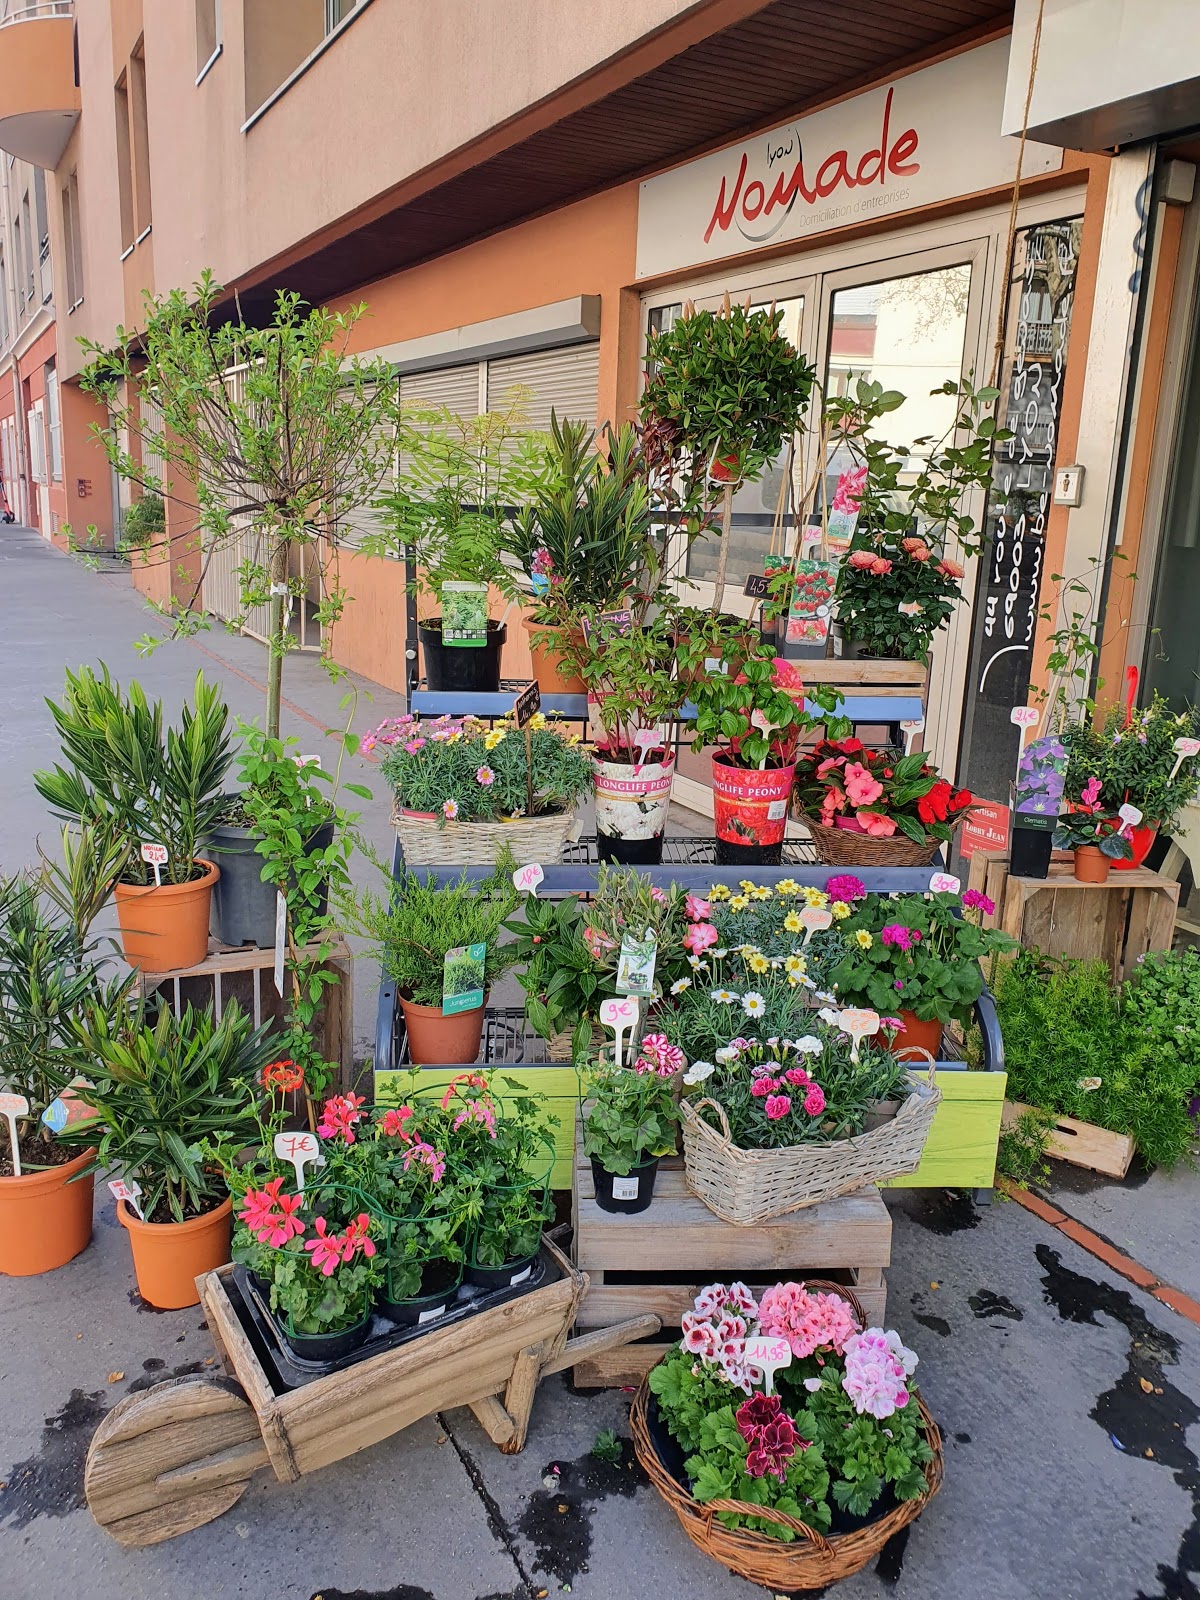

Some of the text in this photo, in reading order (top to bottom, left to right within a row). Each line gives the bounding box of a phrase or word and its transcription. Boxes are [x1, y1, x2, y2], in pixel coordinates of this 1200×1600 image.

[703, 87, 920, 244] Nomade
[799, 188, 910, 227] Domiciliation d'entreprises
[1004, 363, 1042, 639] 69003 LYON
[984, 596, 998, 637] 44
[1007, 414, 1018, 459] de
[1014, 709, 1037, 723] 24€
[599, 777, 647, 791] LONGLIFE
[748, 786, 782, 796] PEONY
[974, 808, 997, 818] Artisan
[519, 866, 540, 886] 18€
[934, 876, 958, 891] 20€
[607, 1002, 632, 1022] 9€
[851, 1020, 871, 1031] 6€
[282, 1136, 314, 1158] 7€
[748, 1341, 789, 1361] 11,90€
